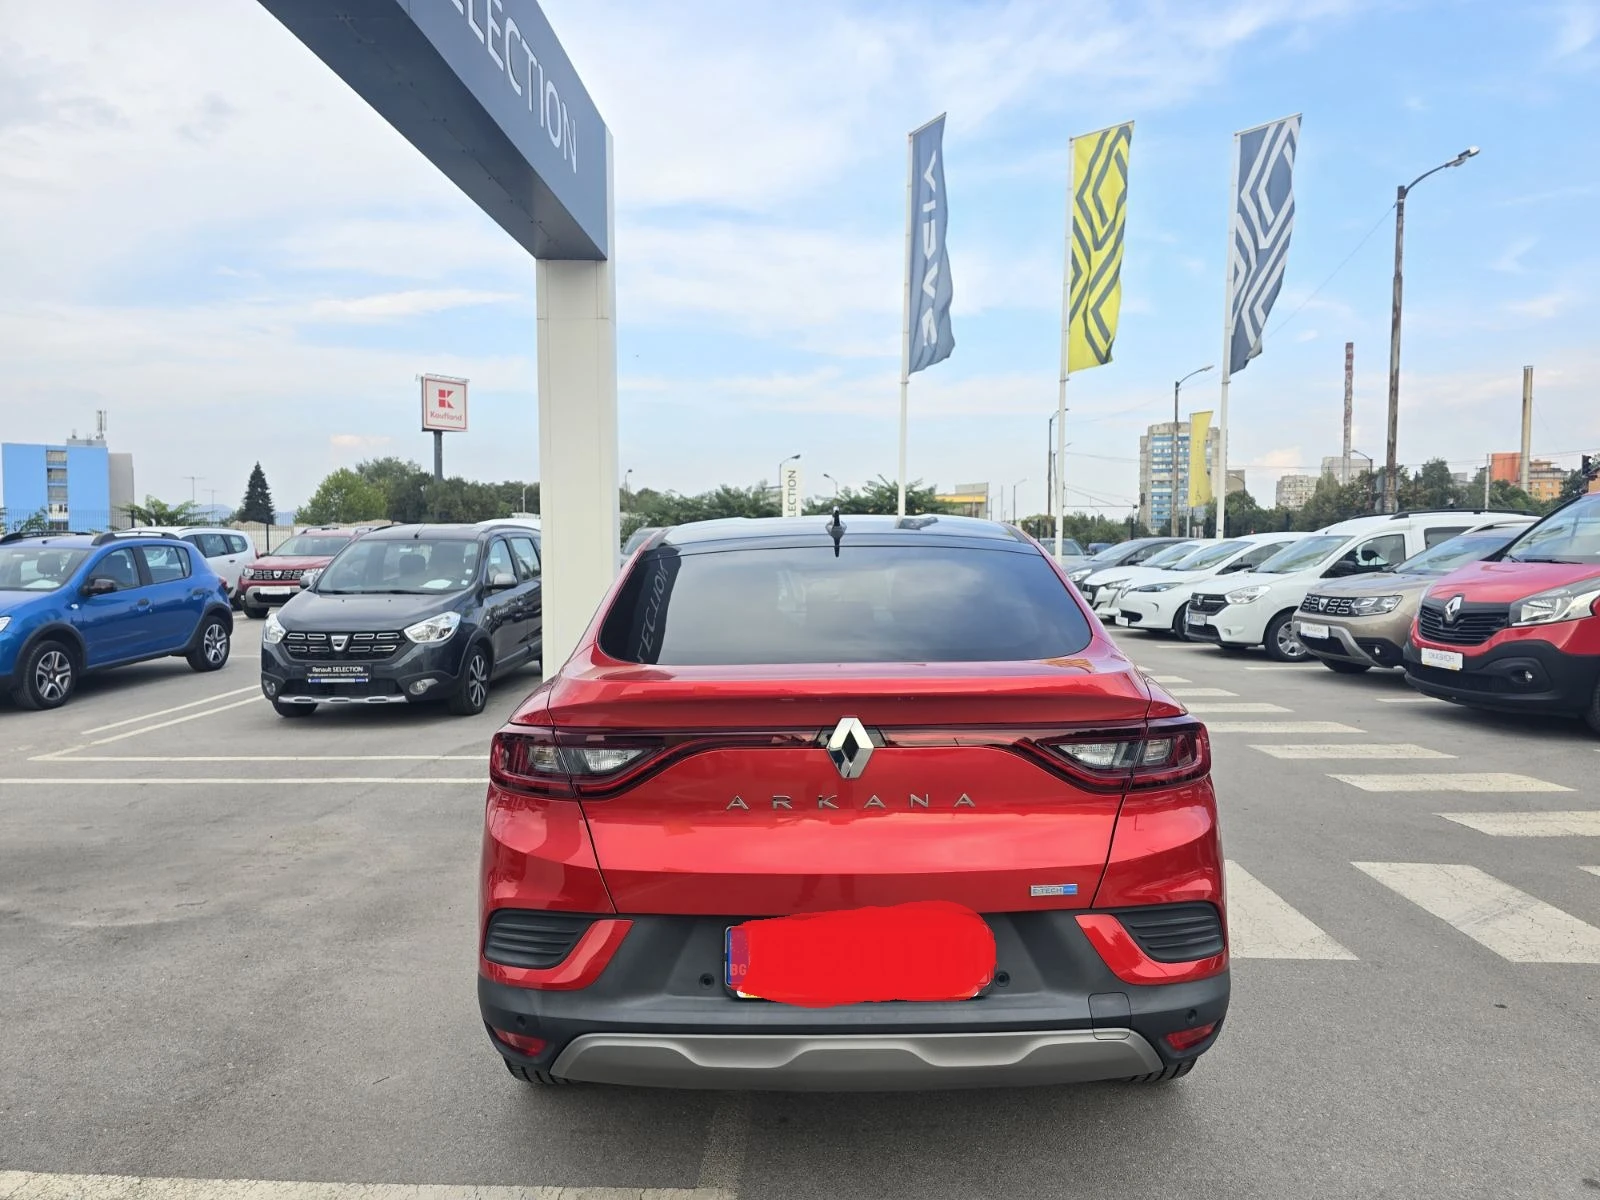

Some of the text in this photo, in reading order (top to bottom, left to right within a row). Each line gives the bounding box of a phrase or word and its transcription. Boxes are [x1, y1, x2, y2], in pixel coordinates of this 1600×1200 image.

[451, 0, 577, 174] LECTION
[430, 410, 463, 422] Kaufland
[726, 793, 976, 810] ARKANA
[730, 963, 747, 976] BG
